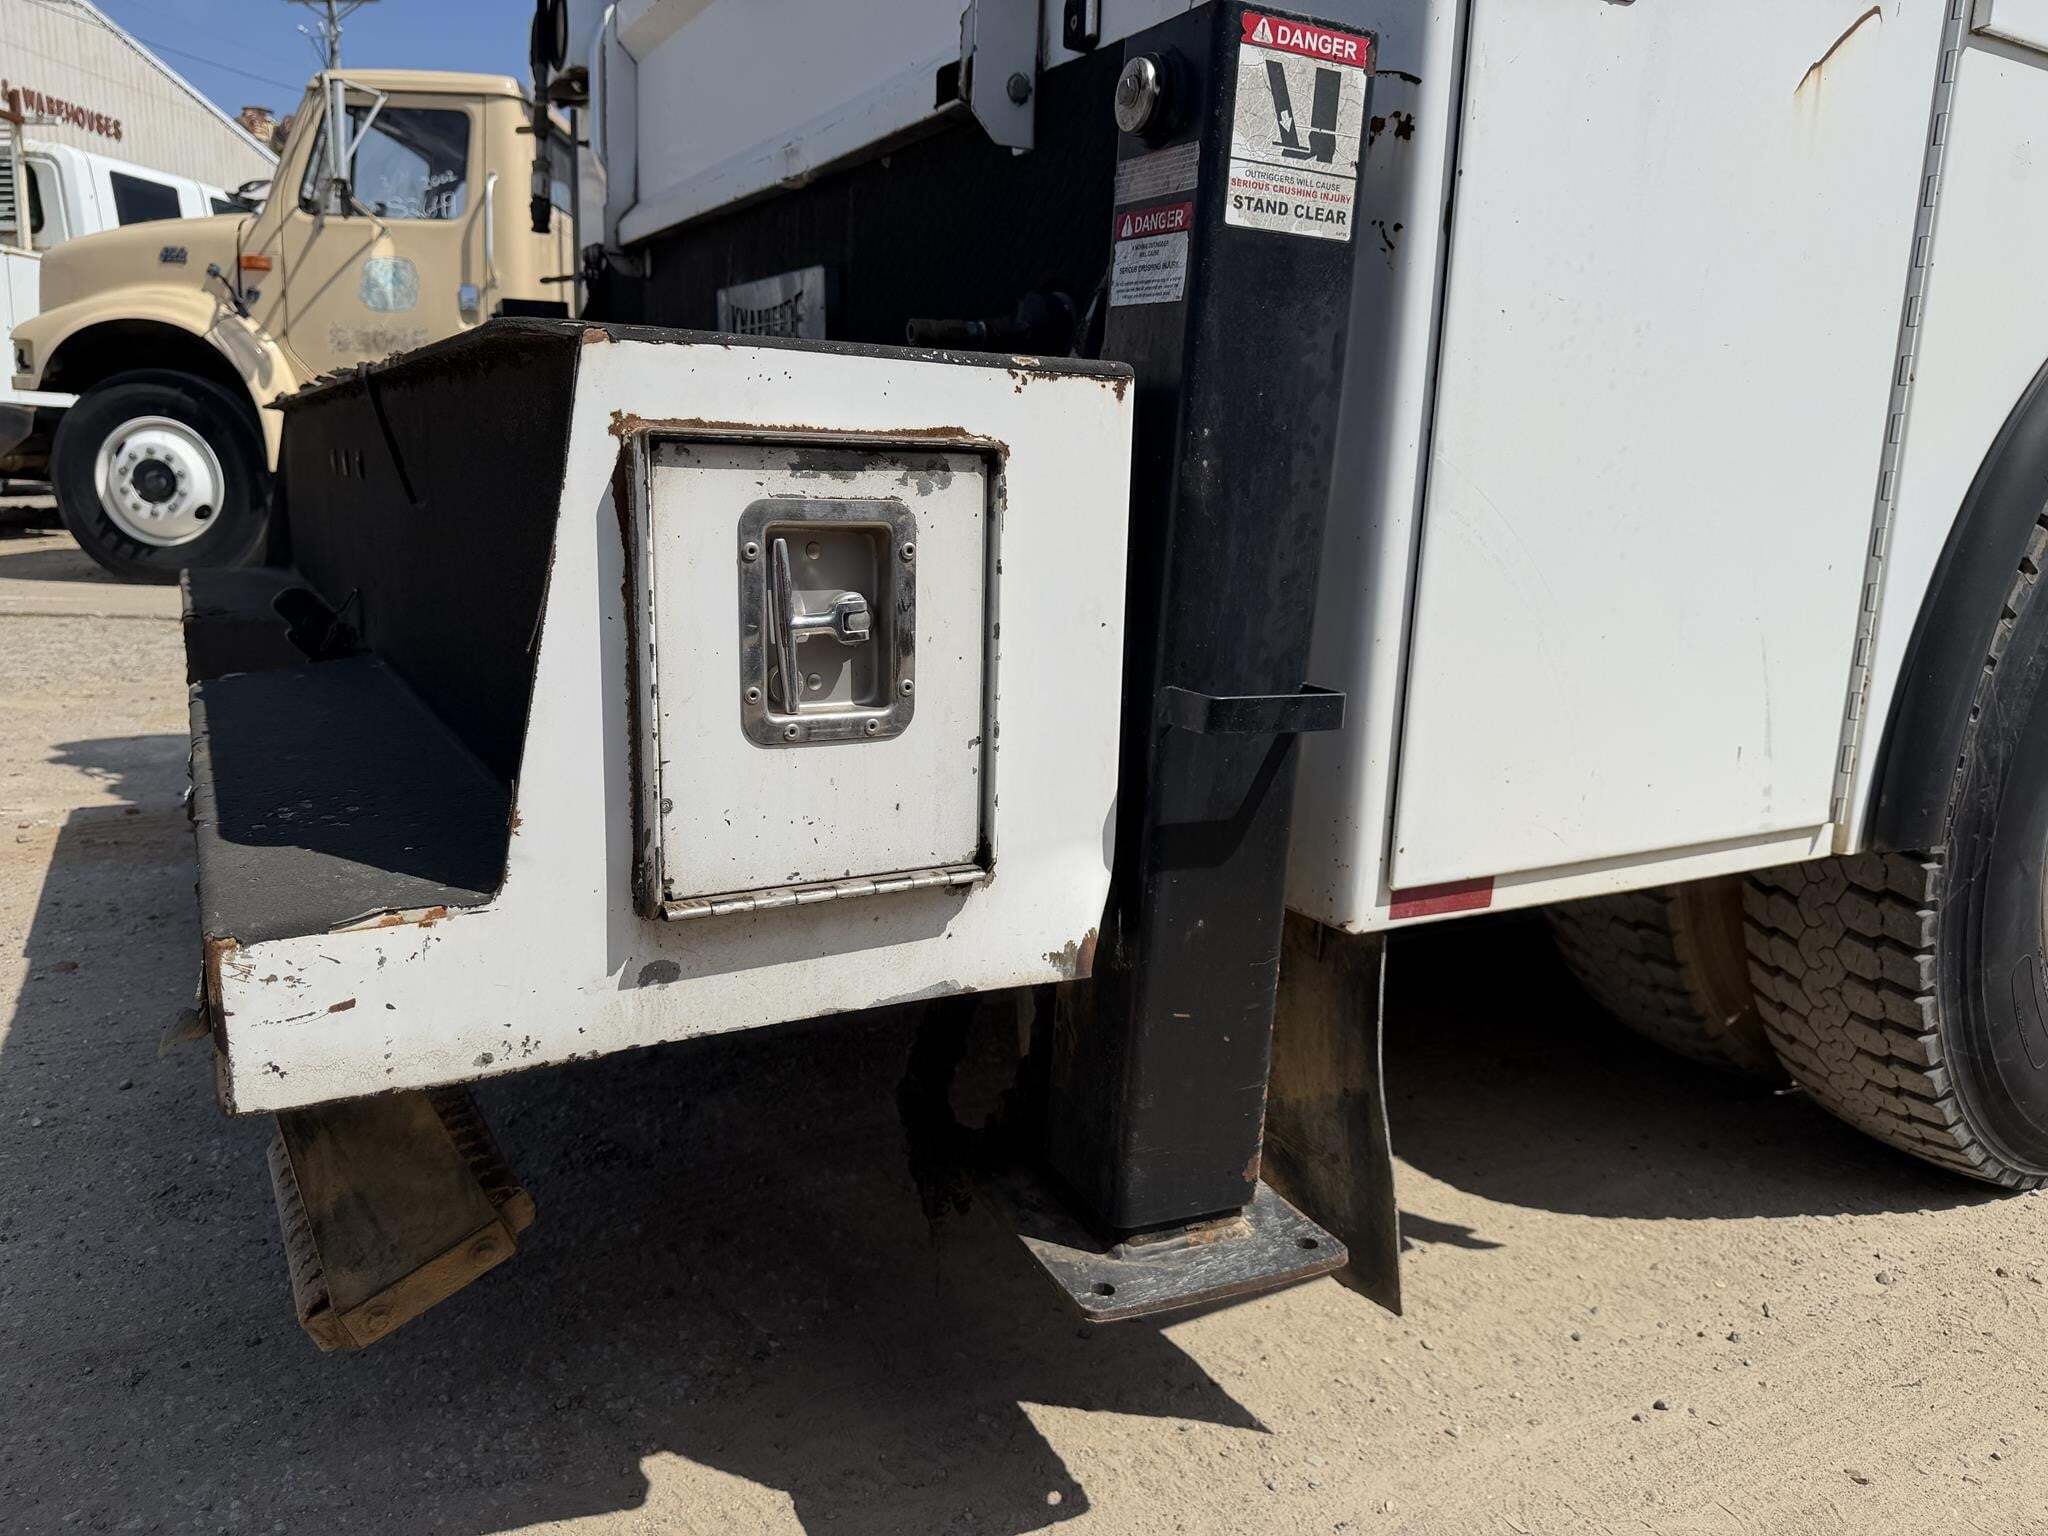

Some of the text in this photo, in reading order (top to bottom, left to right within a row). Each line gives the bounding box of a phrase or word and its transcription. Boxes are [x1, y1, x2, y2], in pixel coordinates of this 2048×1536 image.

[1277, 25, 1357, 61] DANGER
[22, 86, 122, 143] WAREHOUSES
[1231, 178, 1351, 203] SERIOUS CRUSHING INJURY
[1244, 169, 1341, 192] OUTRIGGERS WILL CAUSE
[1134, 209, 1184, 233] DANGER
[1233, 194, 1346, 225] STAND CLEAR
